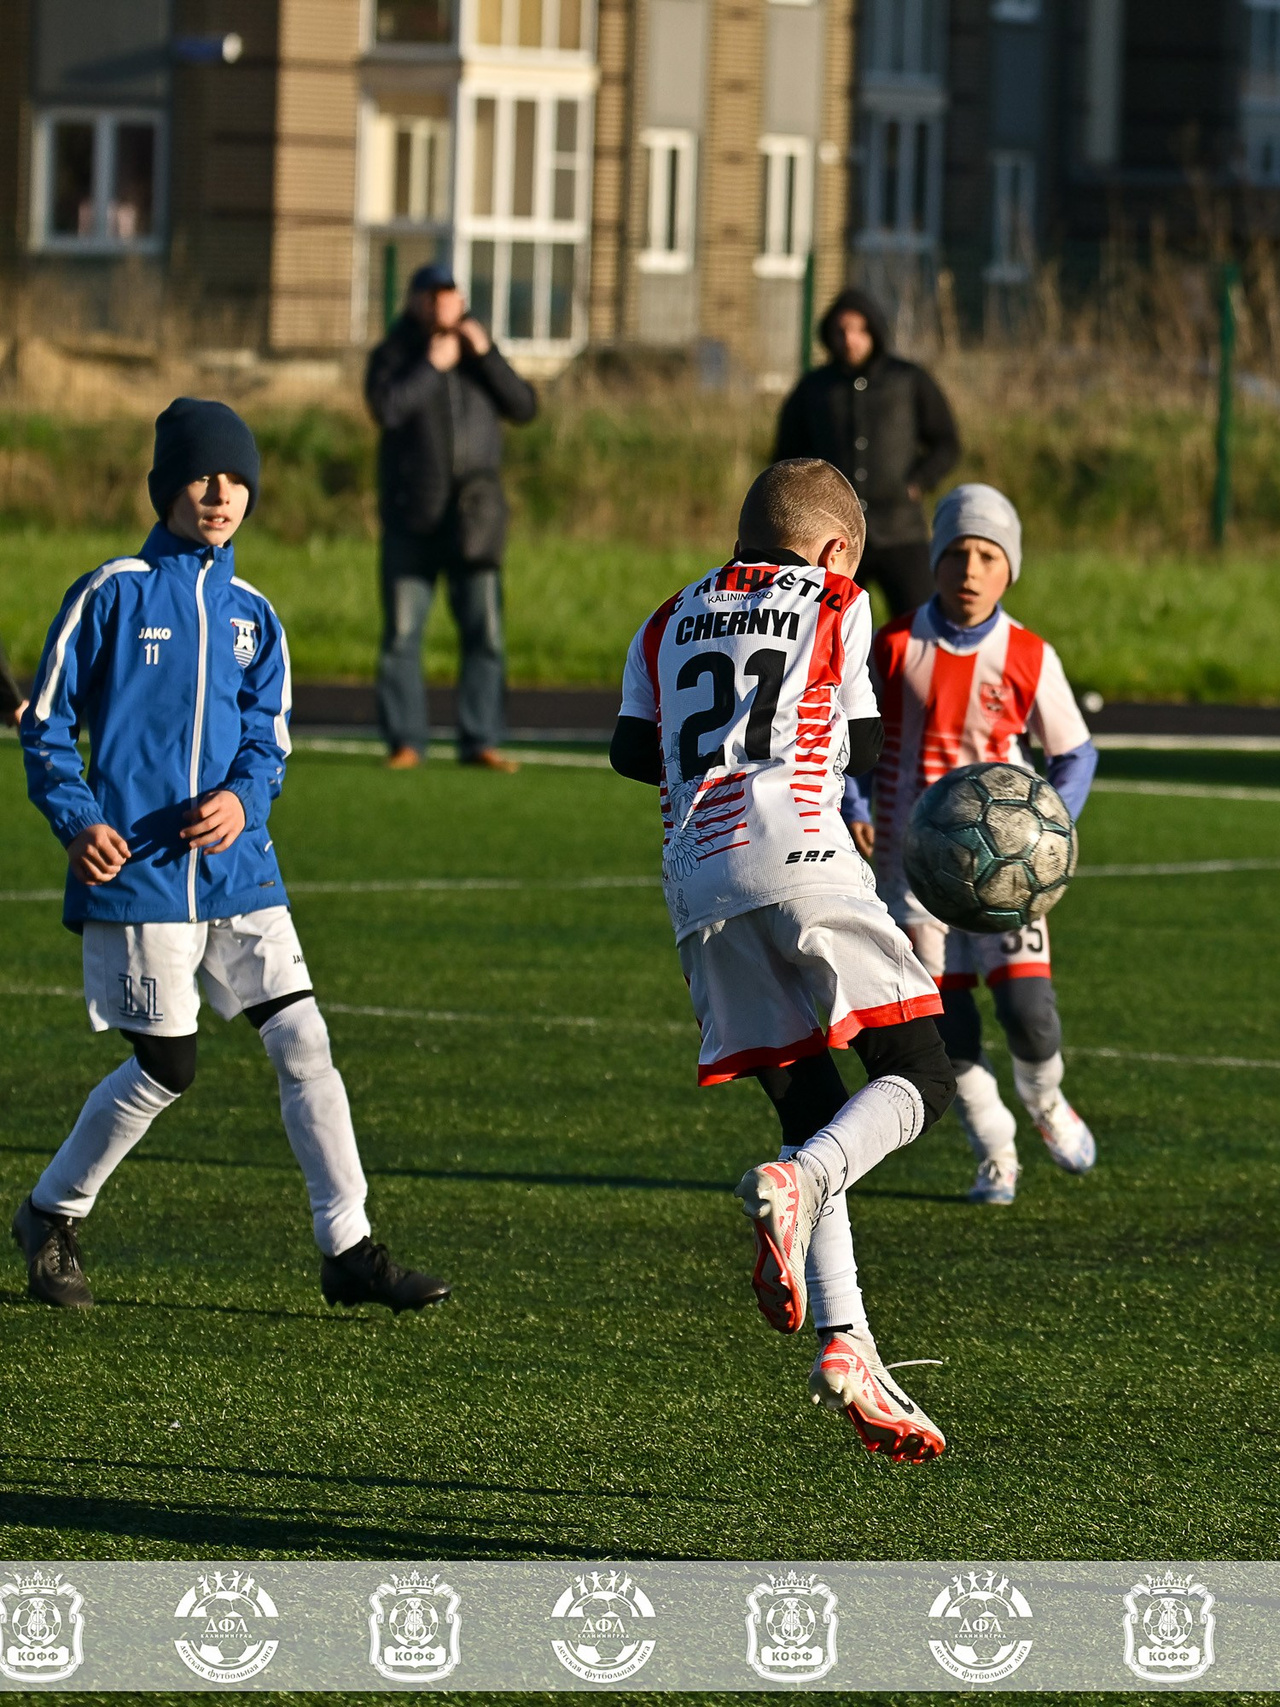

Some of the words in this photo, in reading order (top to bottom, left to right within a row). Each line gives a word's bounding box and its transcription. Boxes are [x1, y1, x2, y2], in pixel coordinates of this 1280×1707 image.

[708, 591, 773, 604] KALININGRAD
[138, 627, 172, 640] JAKO
[675, 608, 800, 646] CHERNYI
[144, 643, 160, 665] 11
[676, 648, 787, 783] 21
[118, 973, 163, 1022] 11
